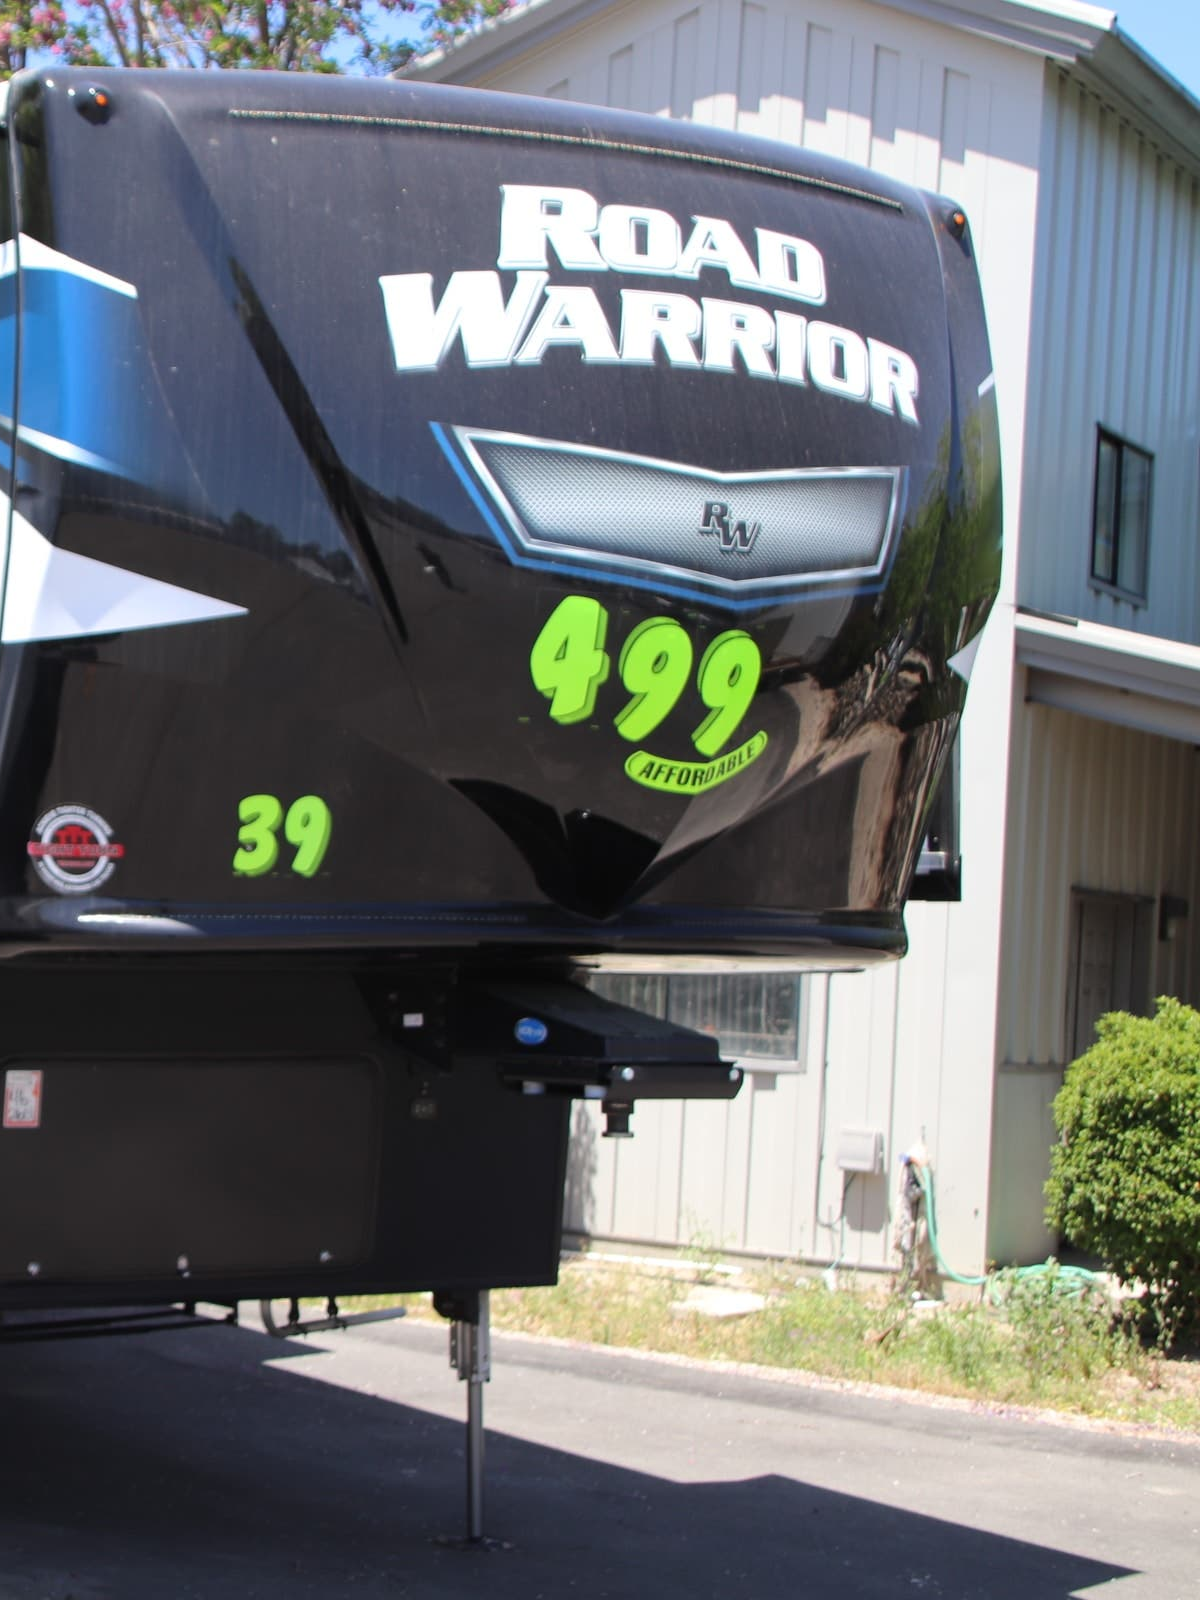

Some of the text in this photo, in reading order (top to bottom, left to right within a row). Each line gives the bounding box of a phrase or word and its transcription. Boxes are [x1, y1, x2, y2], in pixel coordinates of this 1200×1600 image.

[497, 184, 826, 305] ROAD
[379, 270, 919, 427] WARRIOR
[700, 500, 761, 553] RW
[530, 595, 761, 757] 499
[639, 742, 756, 786] AFFORDABLE
[232, 793, 332, 877] 39
